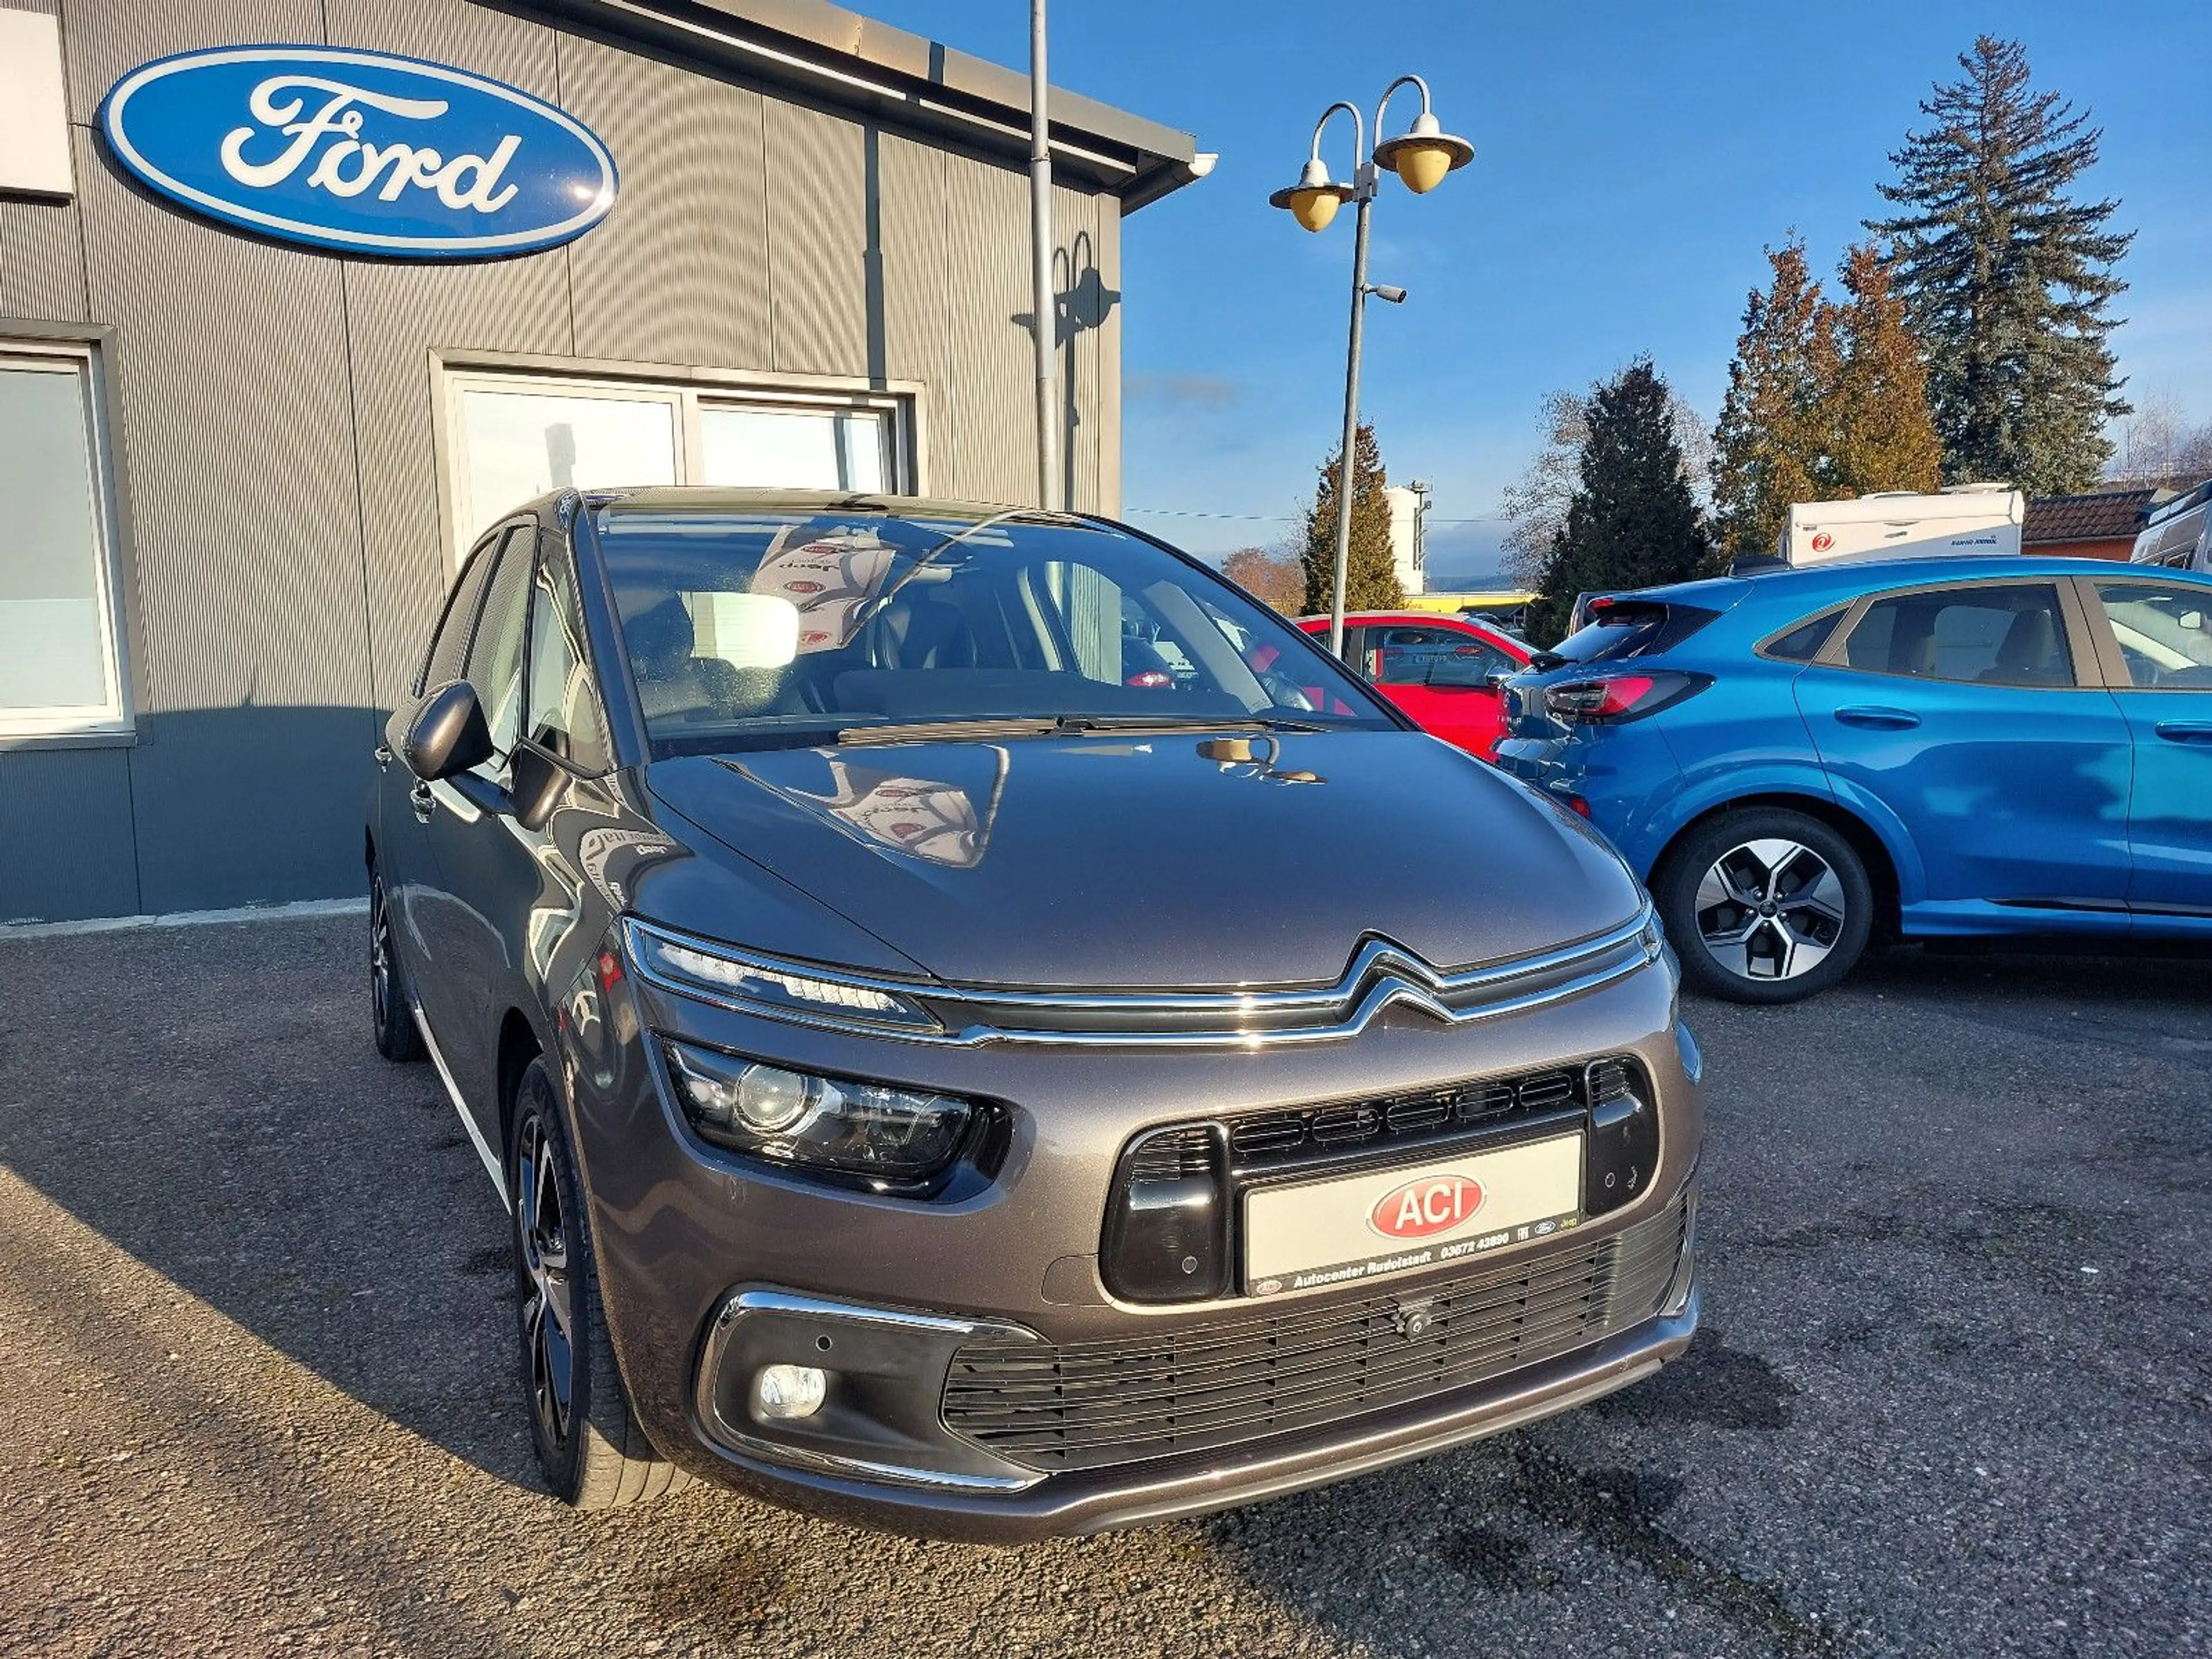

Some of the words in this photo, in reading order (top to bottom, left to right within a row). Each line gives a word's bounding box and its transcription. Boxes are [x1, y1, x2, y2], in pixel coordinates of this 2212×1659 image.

[221, 75, 521, 214] Ford
[1395, 1181, 1463, 1230] ACI
[1293, 1267, 1365, 1288] Autocenter
[1368, 1251, 1432, 1274] Rudolstadt
